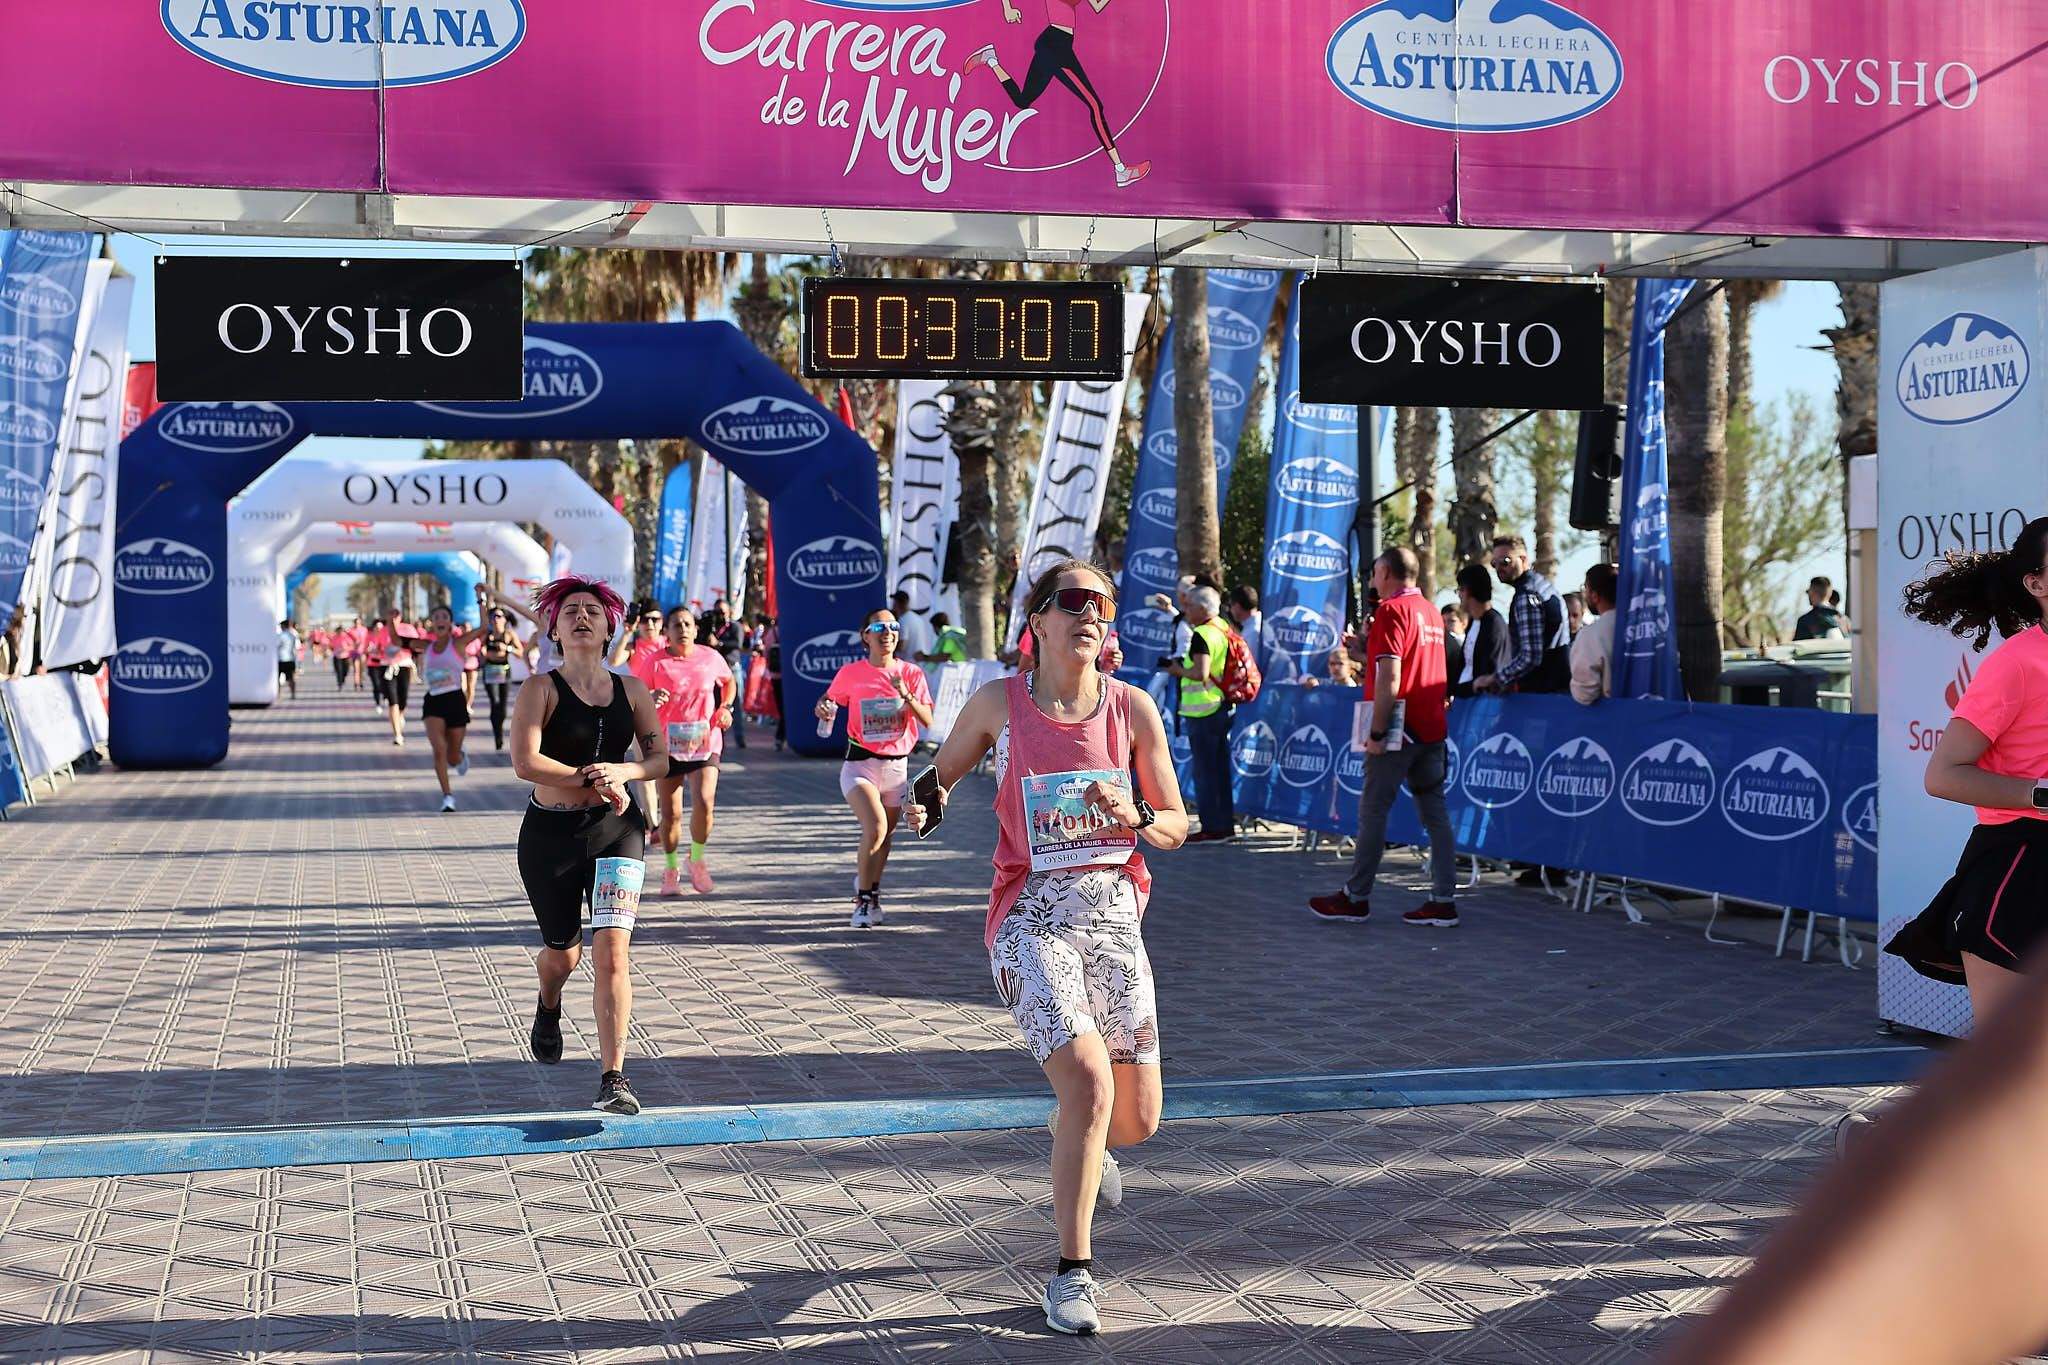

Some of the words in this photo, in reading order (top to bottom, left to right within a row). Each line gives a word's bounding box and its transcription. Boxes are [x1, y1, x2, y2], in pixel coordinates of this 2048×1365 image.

[191, 0, 499, 48] ASTURIANA
[699, 0, 947, 77] Carrera
[1396, 30, 1488, 48] CENTRAL
[1498, 35, 1591, 52] LECHERA
[1349, 31, 1601, 95] ASTURIANA
[1763, 55, 1979, 110] OYSHO
[760, 73, 807, 125] de
[817, 73, 850, 128] la
[842, 72, 1040, 193] Mujer
[217, 303, 473, 358] OYSHO
[1350, 317, 1562, 368] OYSHO
[1905, 359, 2019, 402] ASTURIANA
[167, 412, 284, 439] ASTURIANA
[713, 419, 822, 442] ASTURIANA
[343, 473, 509, 507] OYSHO
[1898, 508, 2028, 561] OYSHO
[115, 559, 207, 582] ASTURIANA
[794, 557, 879, 578] ASTURIANA
[113, 657, 205, 680] ASTURIANA
[1466, 759, 1526, 791] ASTURIANA
[1540, 764, 1607, 798] ASTURIANA
[1626, 769, 1706, 806] ASTURIANA
[1727, 778, 1816, 821] ASTURIANA
[1036, 843, 1064, 854] CARRERA
[1064, 842, 1073, 851] DE
[1073, 841, 1082, 849] LA
[1043, 853, 1078, 865] OYSHO
